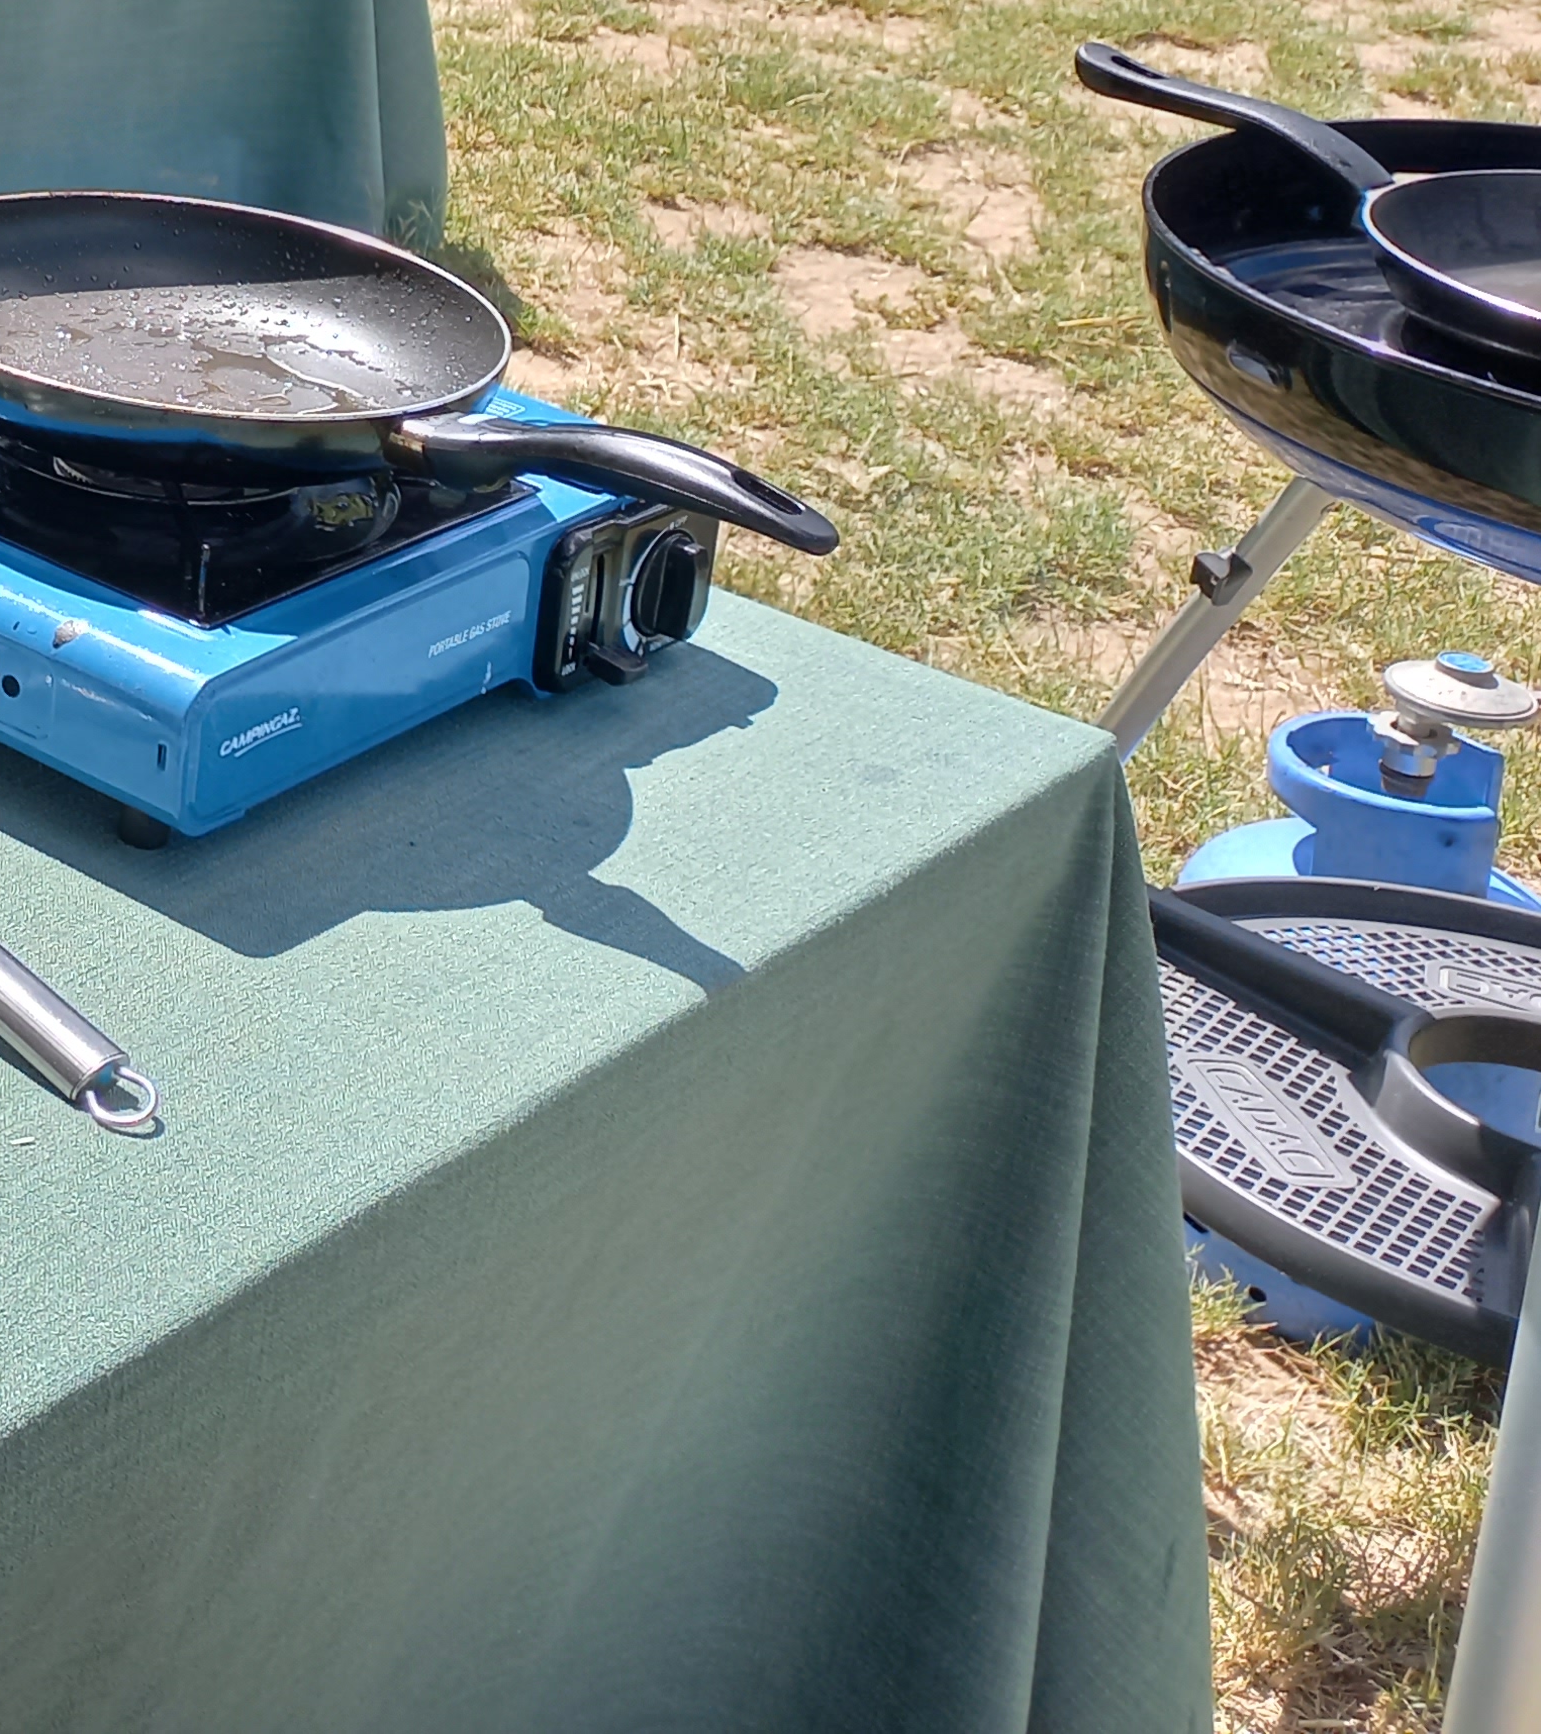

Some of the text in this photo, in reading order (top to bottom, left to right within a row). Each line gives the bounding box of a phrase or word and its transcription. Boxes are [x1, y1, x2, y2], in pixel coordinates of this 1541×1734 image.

[428, 610, 512, 659] PORTABLE GAS STOVE
[219, 707, 300, 757] CAMPINGAZ
[1205, 1067, 1327, 1173] CADAC
